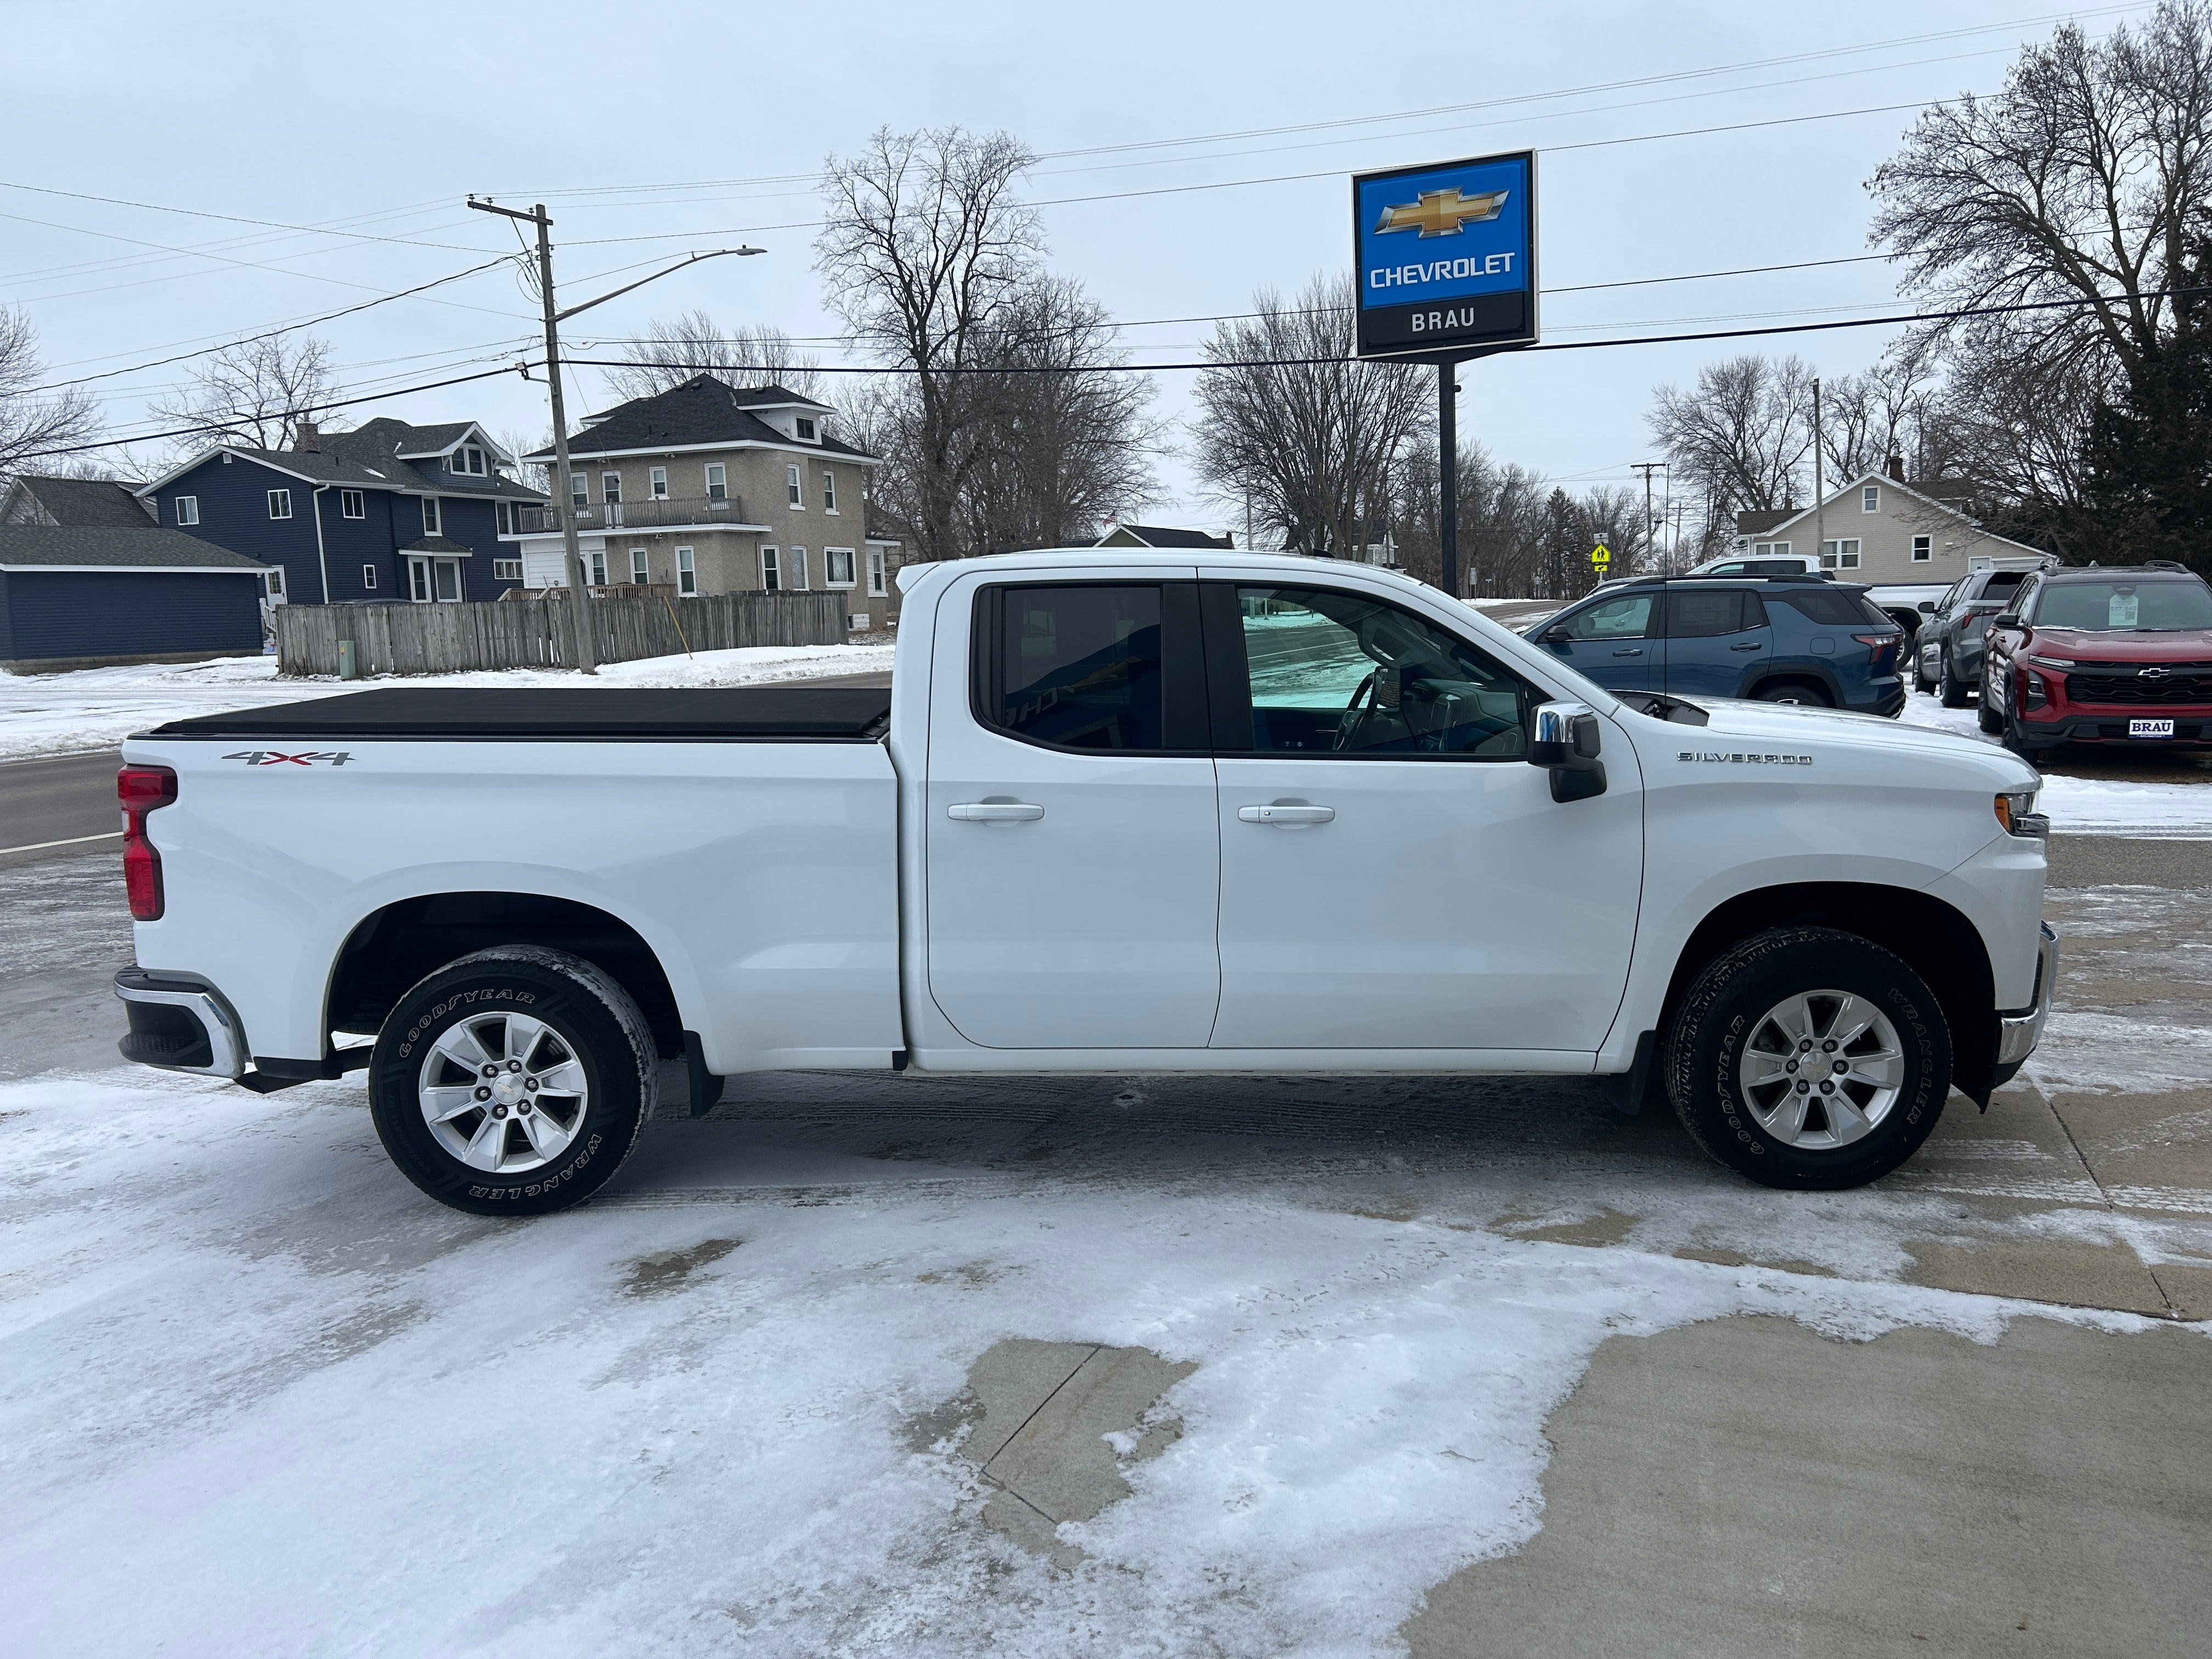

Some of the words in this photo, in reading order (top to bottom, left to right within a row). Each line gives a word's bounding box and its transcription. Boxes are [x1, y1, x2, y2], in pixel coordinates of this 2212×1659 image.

[1370, 252, 1515, 289] CHEVROLET
[1412, 307, 1475, 332] BRAU
[2131, 723, 2171, 732] BRAU
[1677, 751, 1813, 764] SILVERADO
[399, 989, 536, 1058] GOODYEAR
[1887, 988, 1933, 1125] WRANGLER
[1717, 1015, 1764, 1154] GOODYEAR
[469, 1133, 602, 1199] WRANGLER
